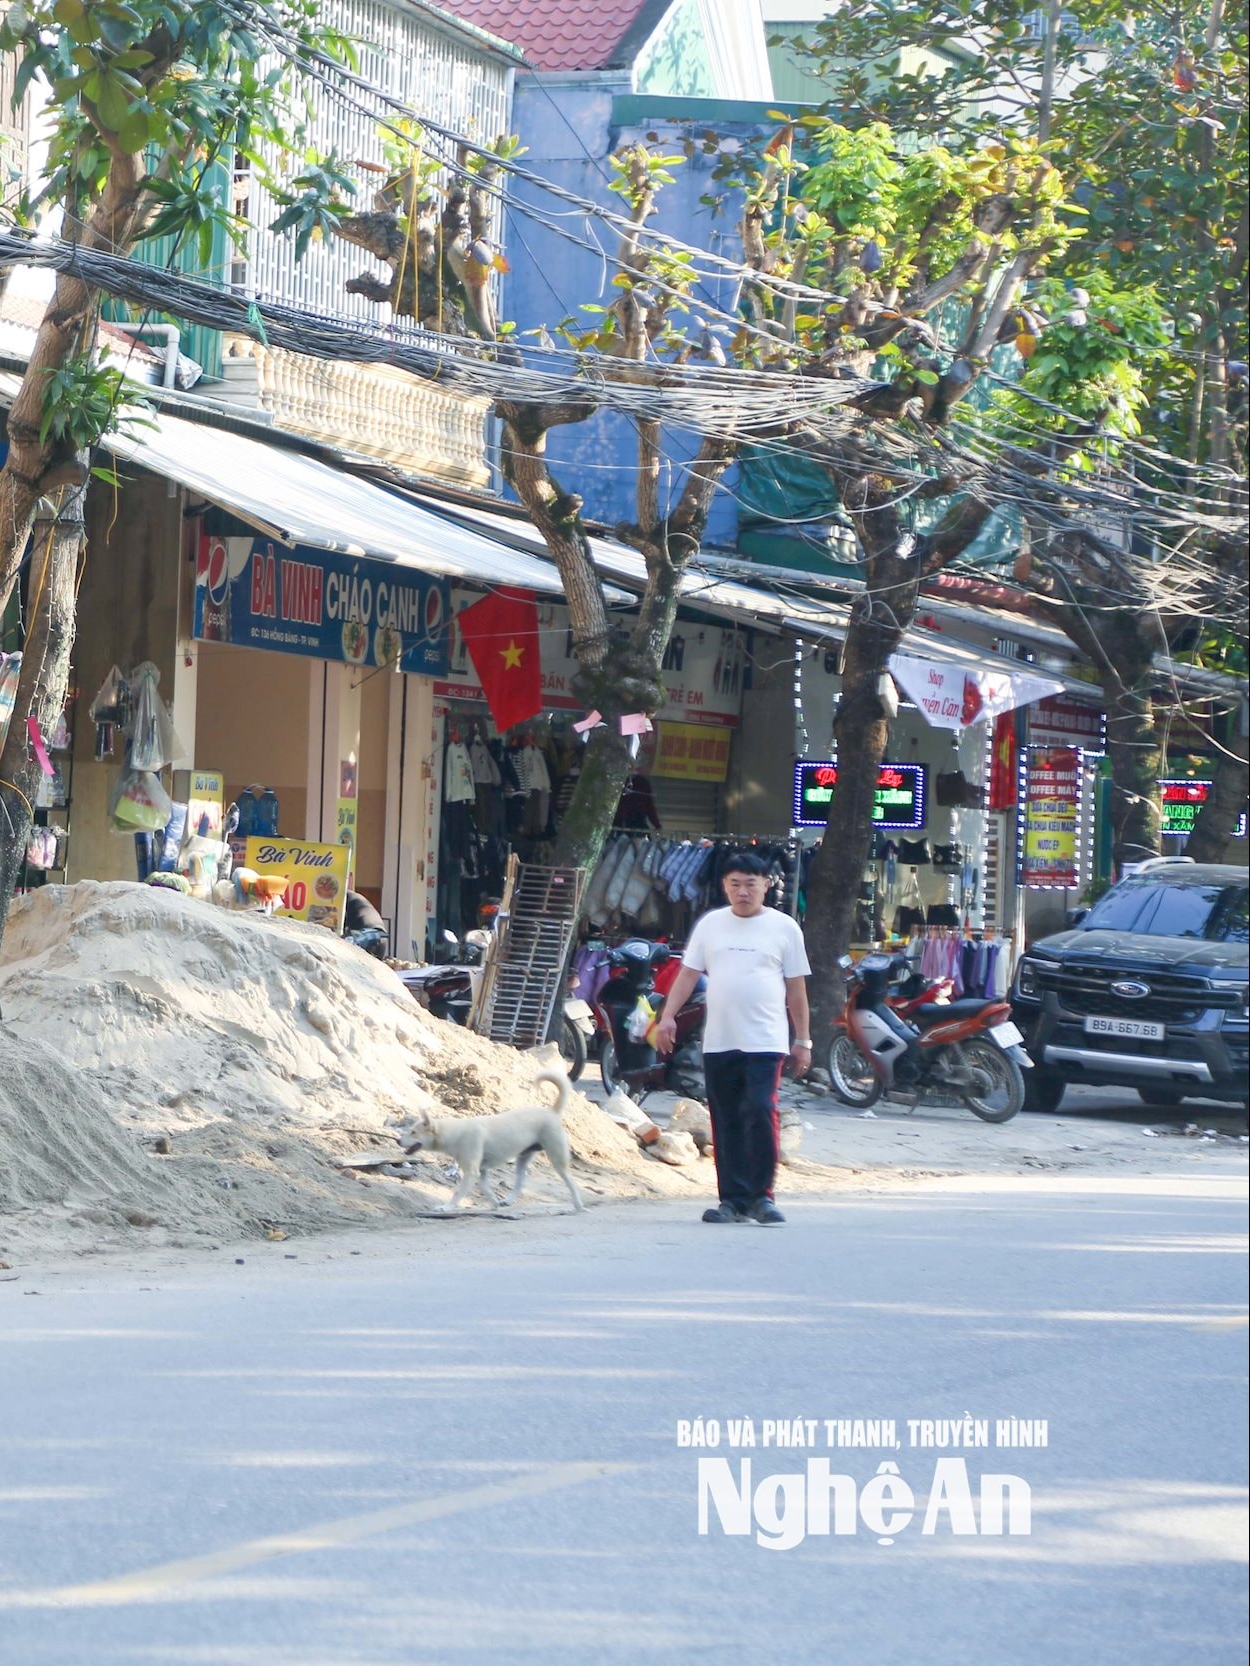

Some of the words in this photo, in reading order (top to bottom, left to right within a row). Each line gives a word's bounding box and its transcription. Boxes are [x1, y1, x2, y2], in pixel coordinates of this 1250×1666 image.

[251, 543, 276, 618] BÀ
[281, 558, 324, 626] VINH
[326, 563, 372, 625] CHÁO
[376, 581, 419, 633] CANH
[927, 668, 944, 689] Shop
[687, 691, 704, 705] EM
[1028, 785, 1056, 795] OFFEE
[256, 845, 287, 864] Bà
[289, 847, 335, 867] Vinh
